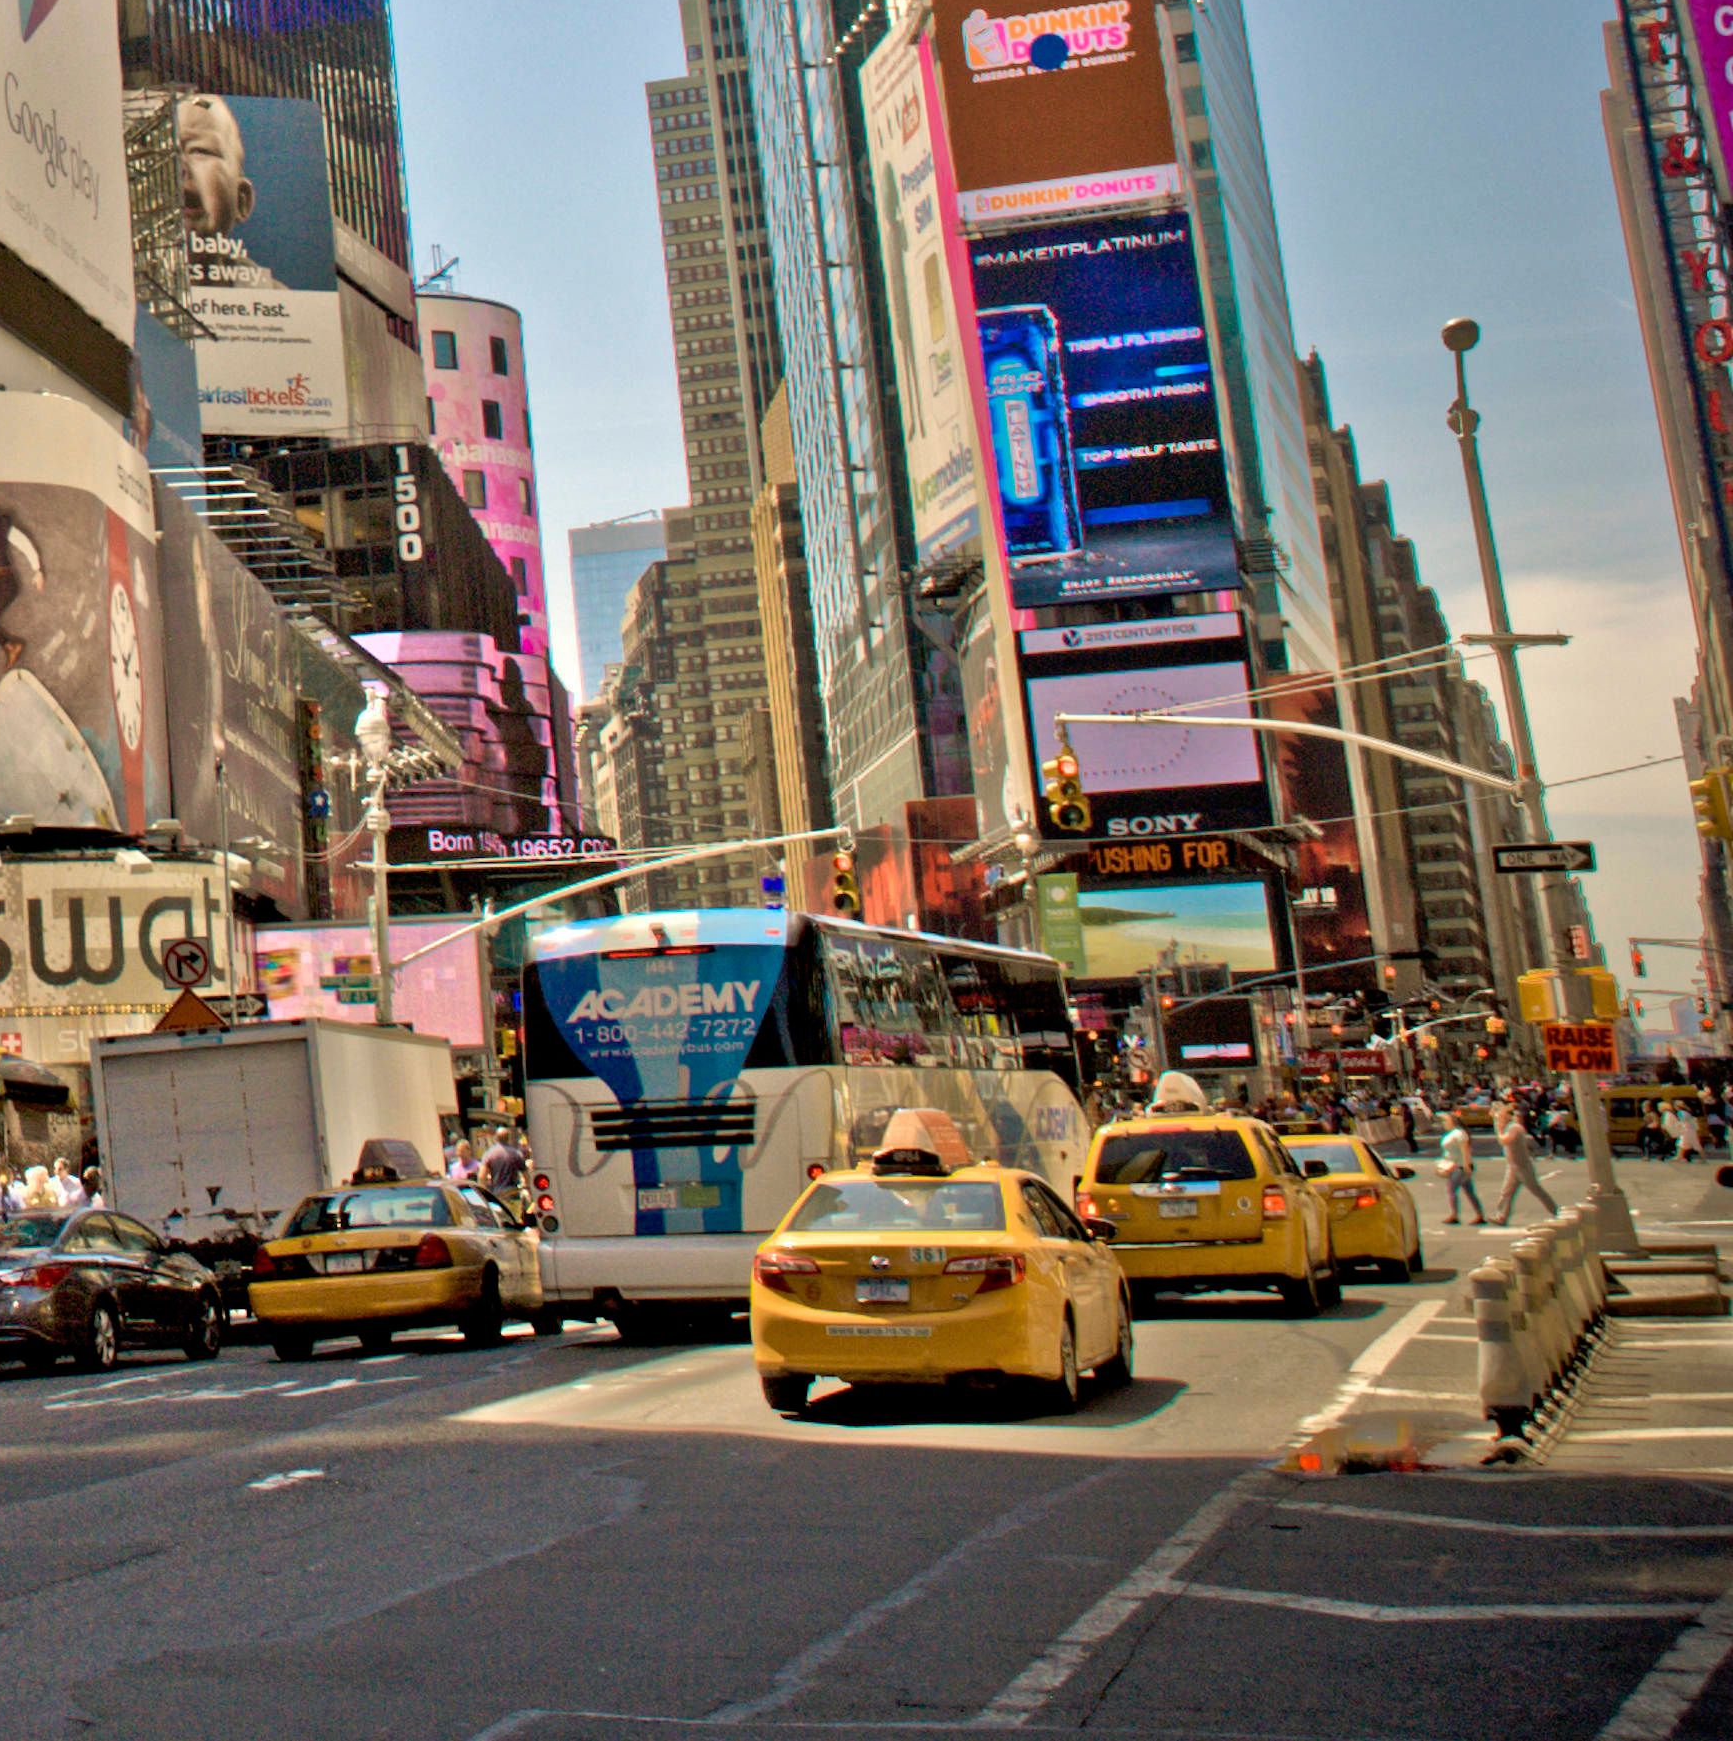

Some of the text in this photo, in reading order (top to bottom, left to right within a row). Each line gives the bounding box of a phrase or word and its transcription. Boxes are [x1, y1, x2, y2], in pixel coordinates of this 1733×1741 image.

[1008, 3, 1125, 40] DUNKIN'
[1012, 25, 1124, 60] DUTS
[5, 71, 100, 220] Google play
[990, 174, 1157, 211] DUNKIN' DONUTS
[190, 231, 247, 259] baby,
[976, 229, 1186, 266] #MAKEITPLATINUM
[208, 265, 267, 285] away.
[192, 299, 291, 318] of here. Fast.
[1083, 448, 1112, 463] TOP
[1166, 438, 1219, 454] TASTE
[395, 446, 422, 562] 1500
[1113, 625, 1170, 640] CENTURY
[1172, 622, 1197, 635] FOX
[1107, 812, 1202, 836] SONY
[1183, 840, 1230, 868] FOR
[565, 979, 762, 1024] ACADEMY
[574, 1017, 757, 1045] 1-800-442-7272
[1547, 1027, 1613, 1048] RAISE
[588, 1040, 746, 1060] www.academybus.com
[1551, 1049, 1613, 1070] PLOW
